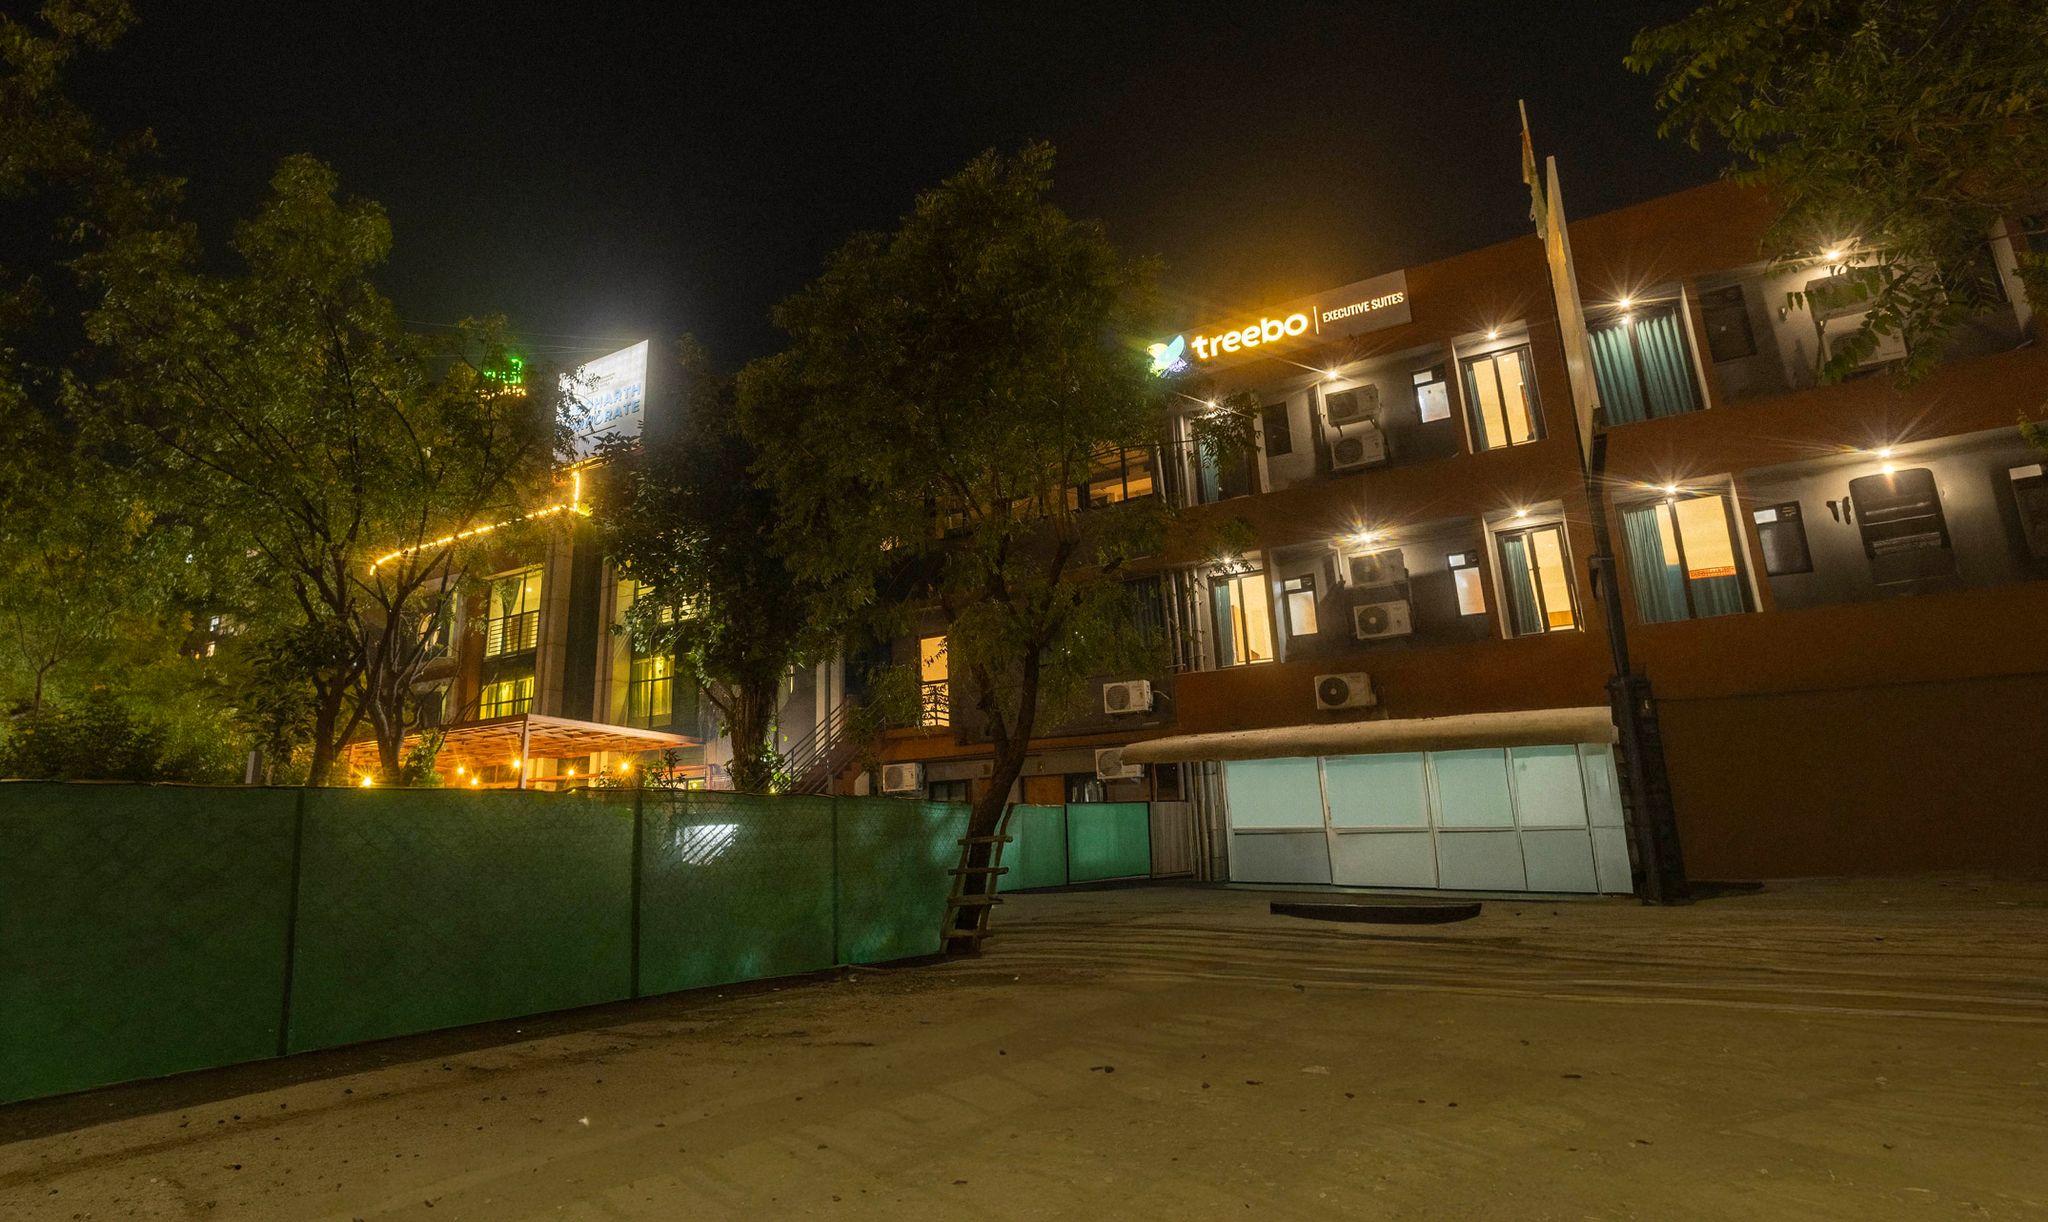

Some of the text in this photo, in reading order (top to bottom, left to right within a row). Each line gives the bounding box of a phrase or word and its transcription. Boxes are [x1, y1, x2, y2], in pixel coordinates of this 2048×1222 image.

[1322, 292, 1404, 323] EXECUTIVE SUITES
[1191, 313, 1308, 359] treebo
